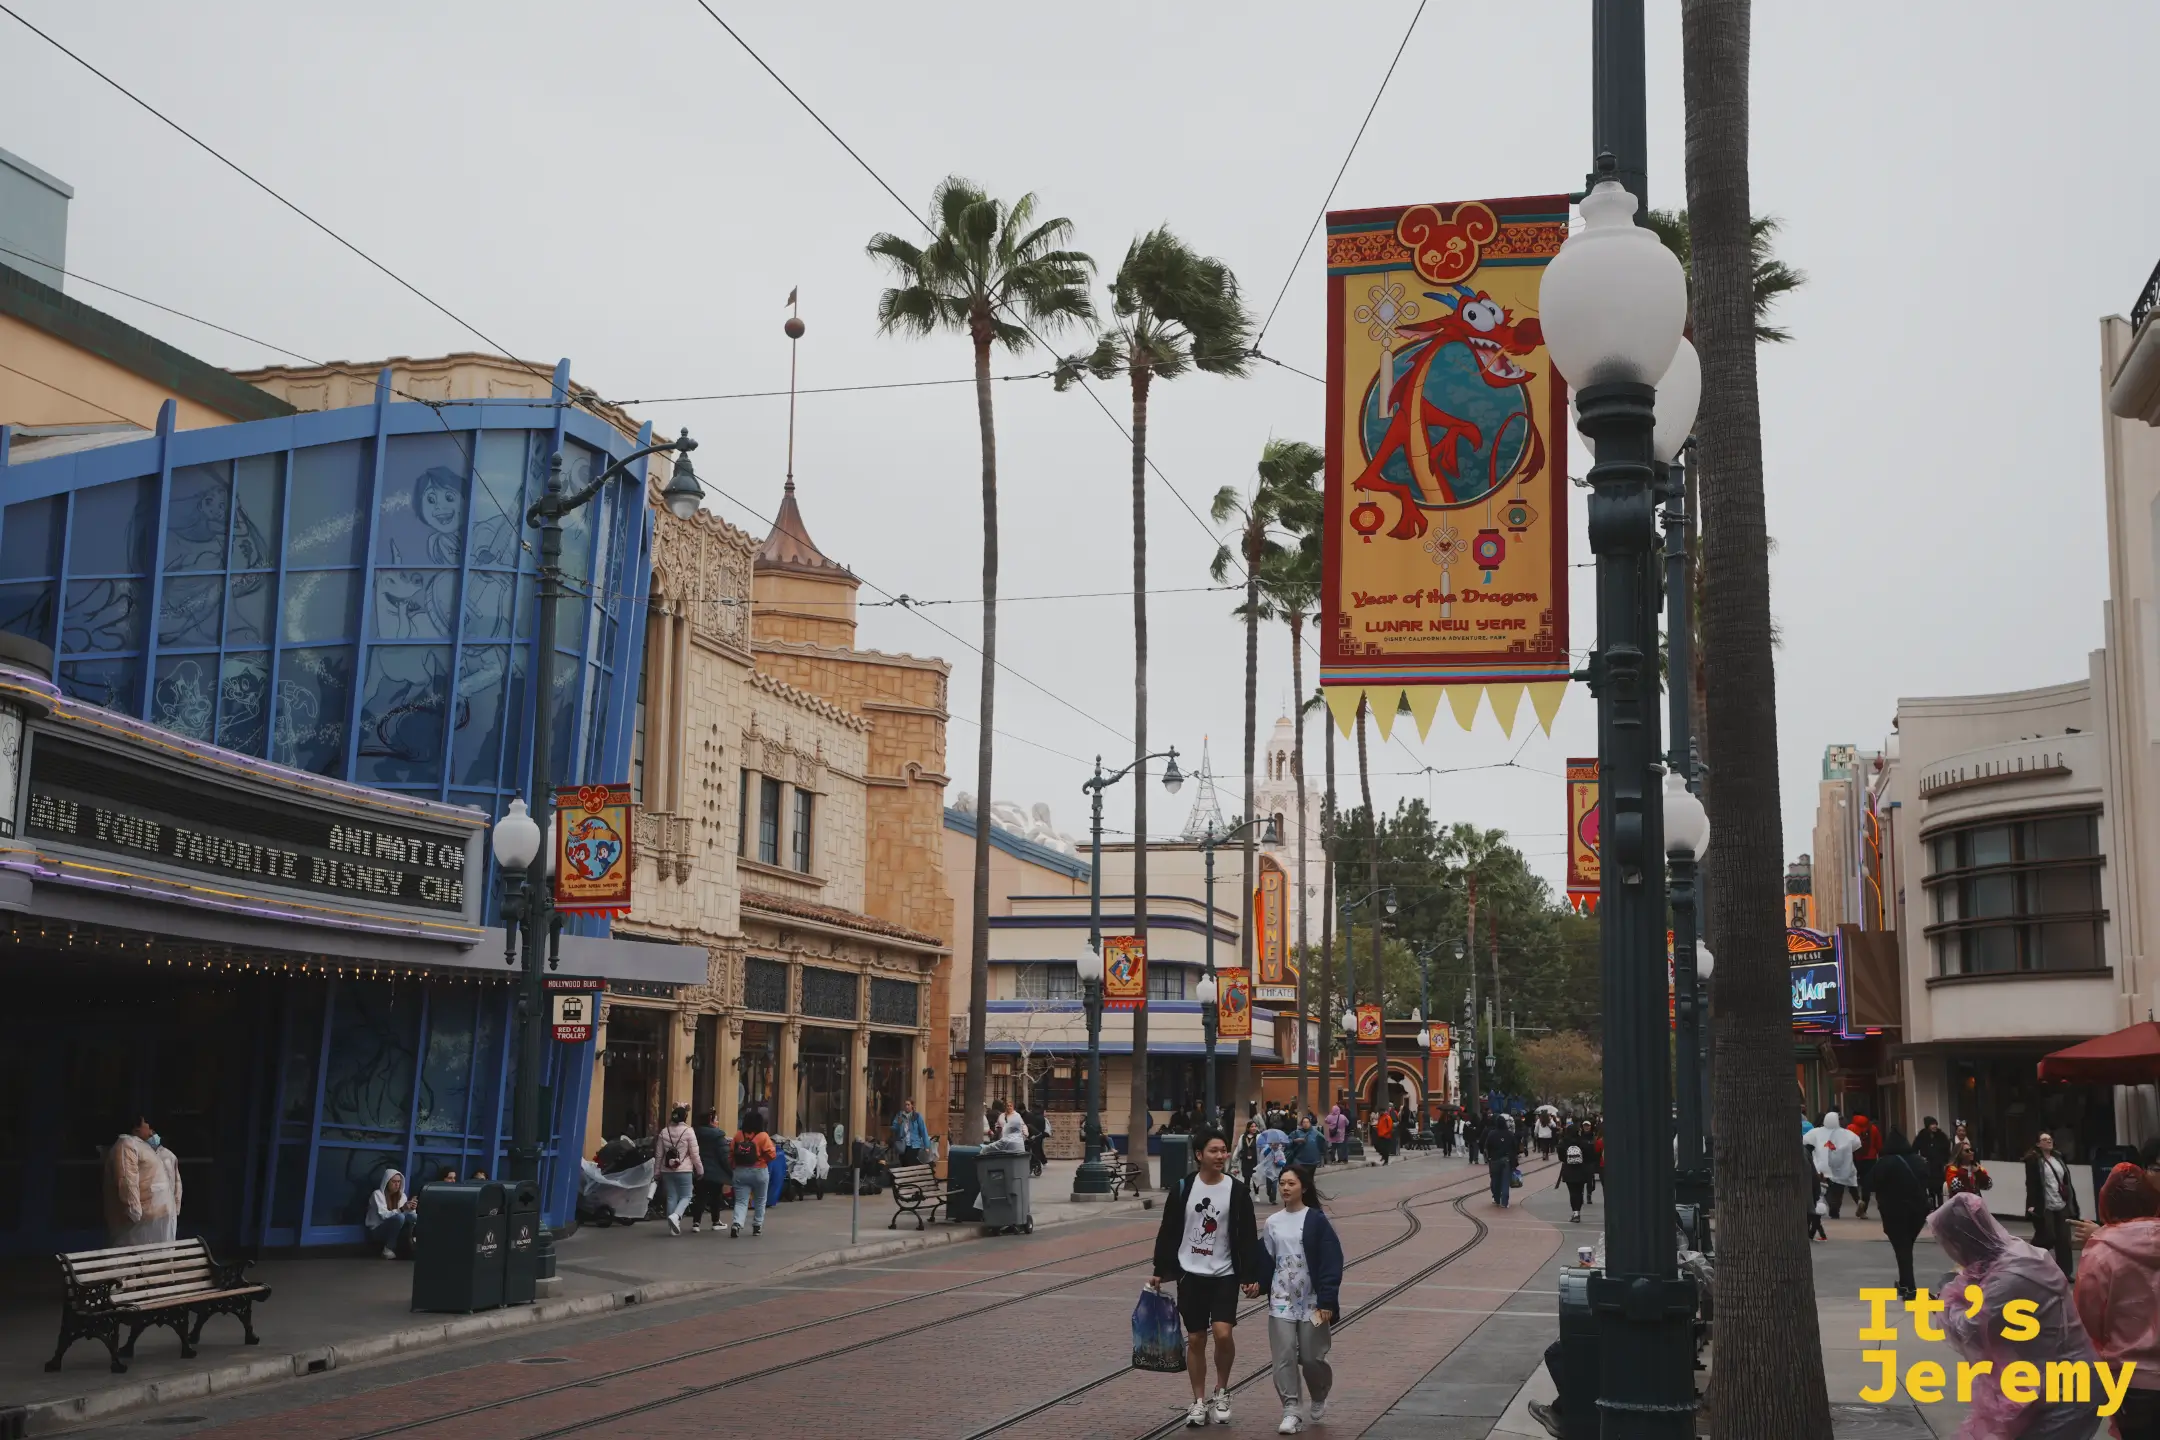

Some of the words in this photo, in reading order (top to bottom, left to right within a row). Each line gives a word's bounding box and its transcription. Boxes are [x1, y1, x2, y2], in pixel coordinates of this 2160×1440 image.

[1351, 591, 1398, 608] Year
[1402, 589, 1425, 608] of
[1426, 588, 1458, 605] the
[1461, 588, 1539, 607] Dragon
[1365, 619, 1423, 632] LUNAR
[1429, 619, 1470, 632] NEW
[1476, 618, 1526, 631] YEAR
[95, 807, 162, 853] YOUR
[173, 827, 299, 880] FAVORITE
[310, 856, 403, 897] DISNEY
[1265, 878, 1278, 978] DISNEY
[548, 980, 581, 988] HOLLYWOOD
